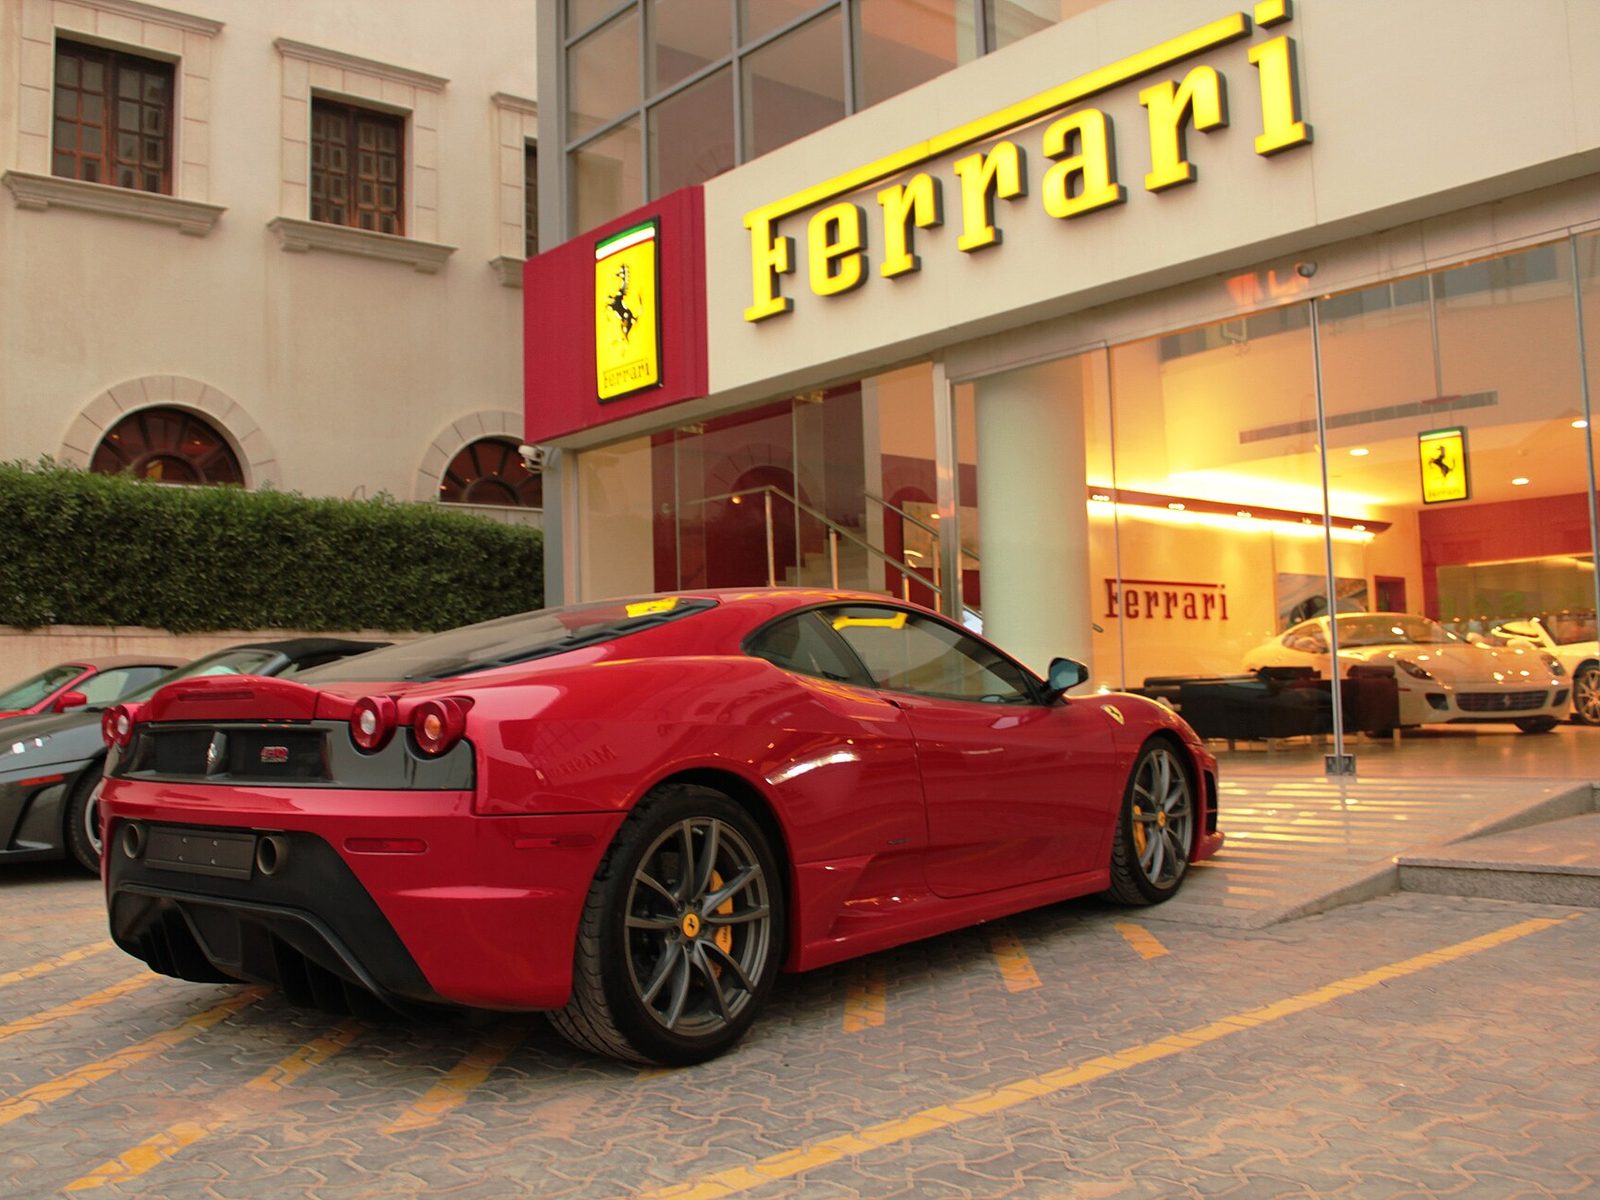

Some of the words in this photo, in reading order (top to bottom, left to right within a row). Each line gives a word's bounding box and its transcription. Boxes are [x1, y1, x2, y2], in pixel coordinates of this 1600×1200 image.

[743, 0, 1313, 323] Ferrari
[602, 358, 650, 389] Ferrari
[1104, 578, 1229, 620] Ferrari
